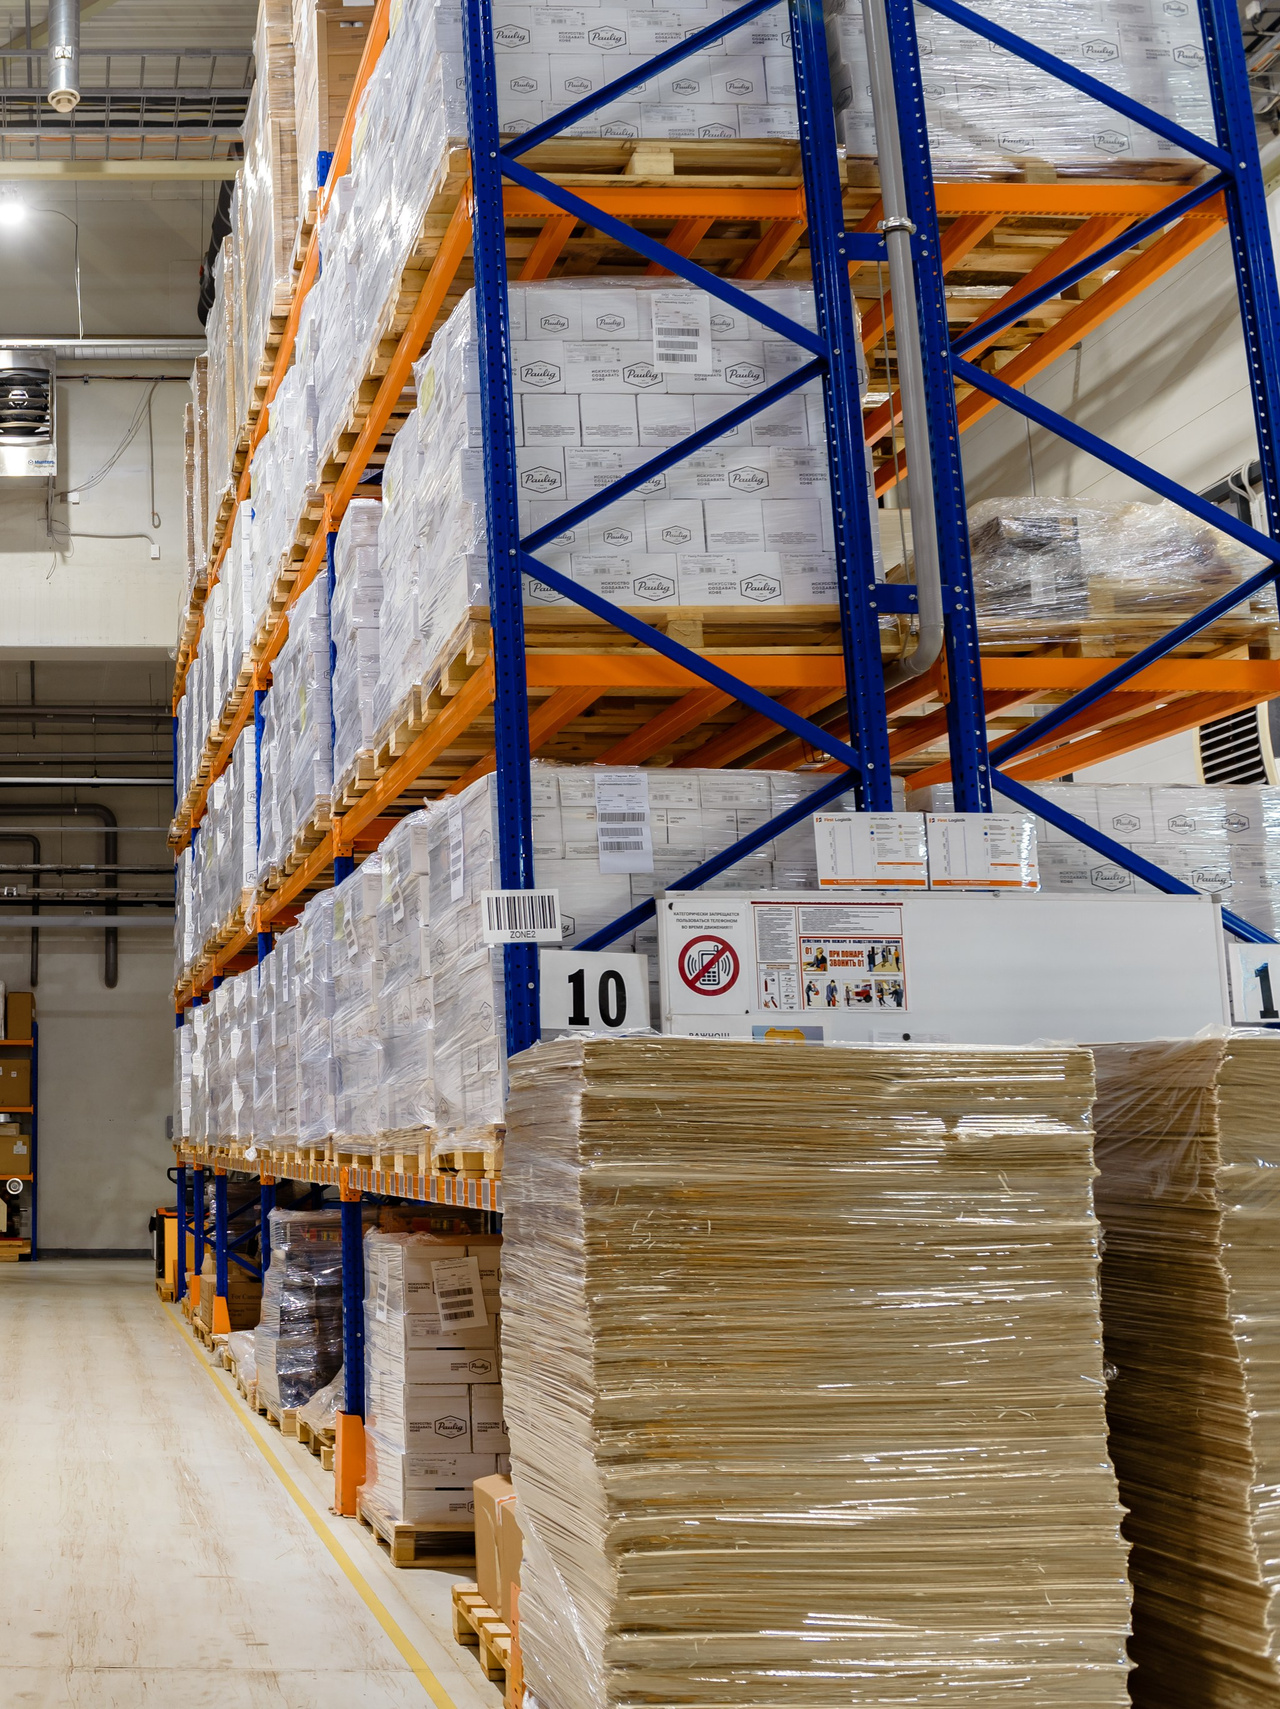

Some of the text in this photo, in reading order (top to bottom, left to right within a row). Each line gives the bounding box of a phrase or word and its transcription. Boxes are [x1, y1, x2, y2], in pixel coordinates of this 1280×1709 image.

[496, 31, 526, 42] Paulig
[592, 32, 623, 44] Paulig
[1086, 46, 1115, 56] Paulig
[1178, 52, 1204, 62] Paulig
[514, 82, 534, 90] Paulig
[568, 82, 589, 90] Paulig
[675, 84, 696, 92] Paulig
[728, 83, 750, 91] Paulig
[1098, 136, 1126, 148] Paulig
[544, 318, 566, 328] Paulig
[600, 318, 622, 328] Paulig
[524, 368, 556, 380] Paulig
[626, 368, 659, 381] Paulig
[730, 369, 762, 381] Paulig
[526, 474, 558, 486] Paulig
[733, 474, 765, 486] Paulig
[606, 532, 629, 541] Paulig
[666, 530, 688, 539] Paulig
[638, 582, 670, 594] Paulig
[744, 582, 777, 594] Paulig
[1116, 818, 1137, 827] Paulig
[1171, 820, 1192, 829] Paulig
[1224, 819, 1246, 827] Paulig
[1094, 871, 1126, 884] Paulig
[510, 931, 536, 939] ZONE2
[1255, 962, 1279, 1018] 1
[568, 968, 626, 1027] 10
[438, 1422, 464, 1432] Paulig
